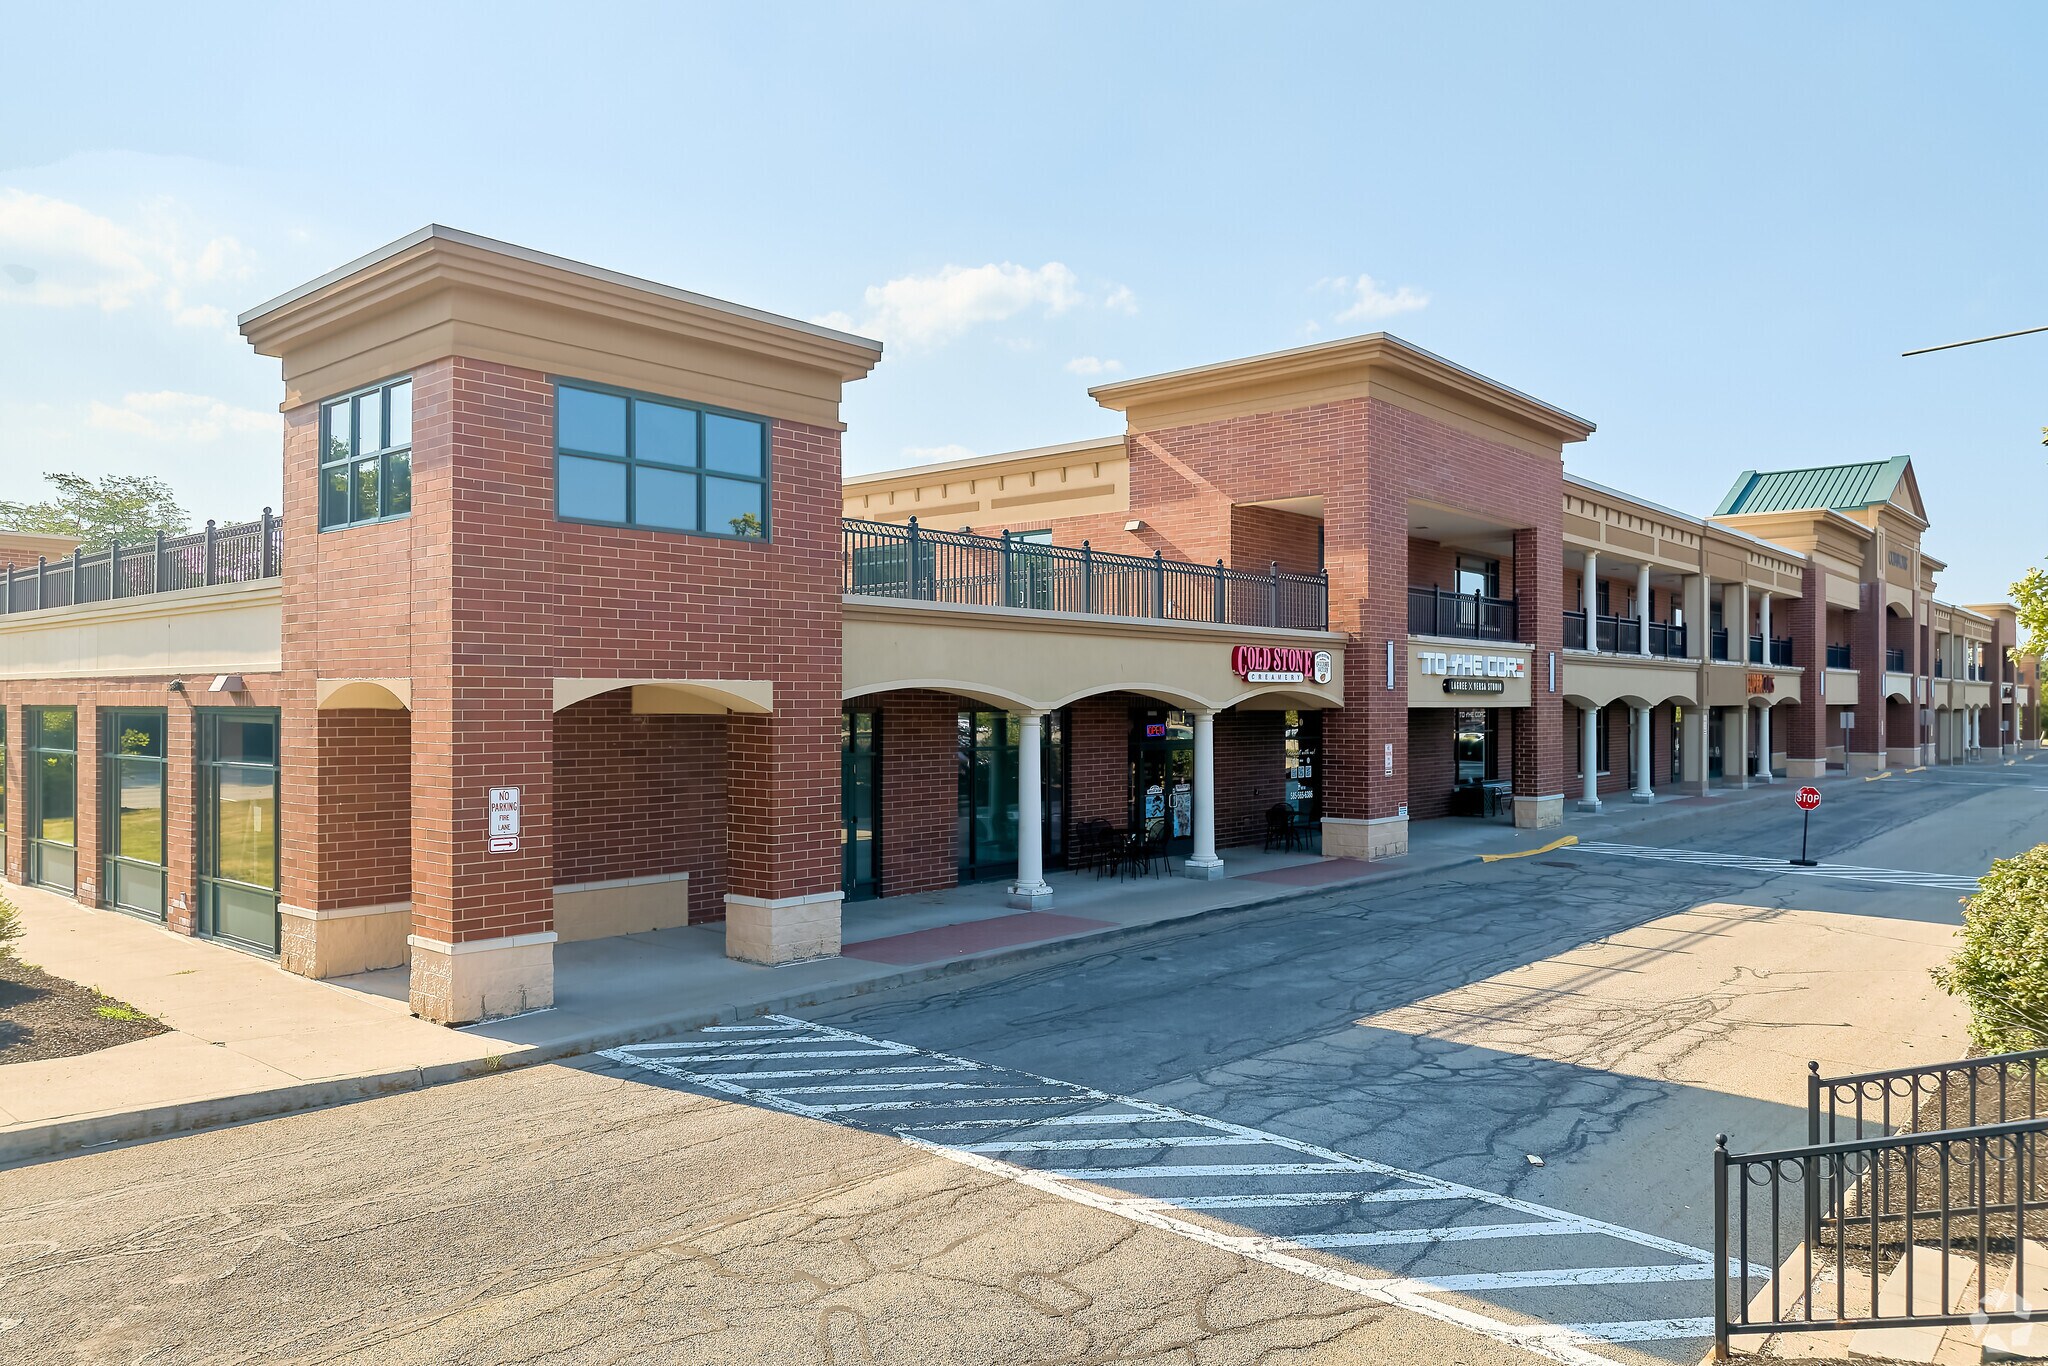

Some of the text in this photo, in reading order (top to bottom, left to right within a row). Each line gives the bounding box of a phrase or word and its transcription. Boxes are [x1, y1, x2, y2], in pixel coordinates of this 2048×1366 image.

[1237, 645, 1271, 676] COLD
[1273, 647, 1313, 677] STONE
[1418, 652, 1447, 675] TO
[1487, 656, 1525, 678] CORE
[1251, 673, 1301, 681] CREAMERY
[1148, 726, 1163, 735] OPEN
[499, 791, 510, 801] NO
[1796, 793, 1820, 803] STOP
[491, 802, 518, 812] PARKING
